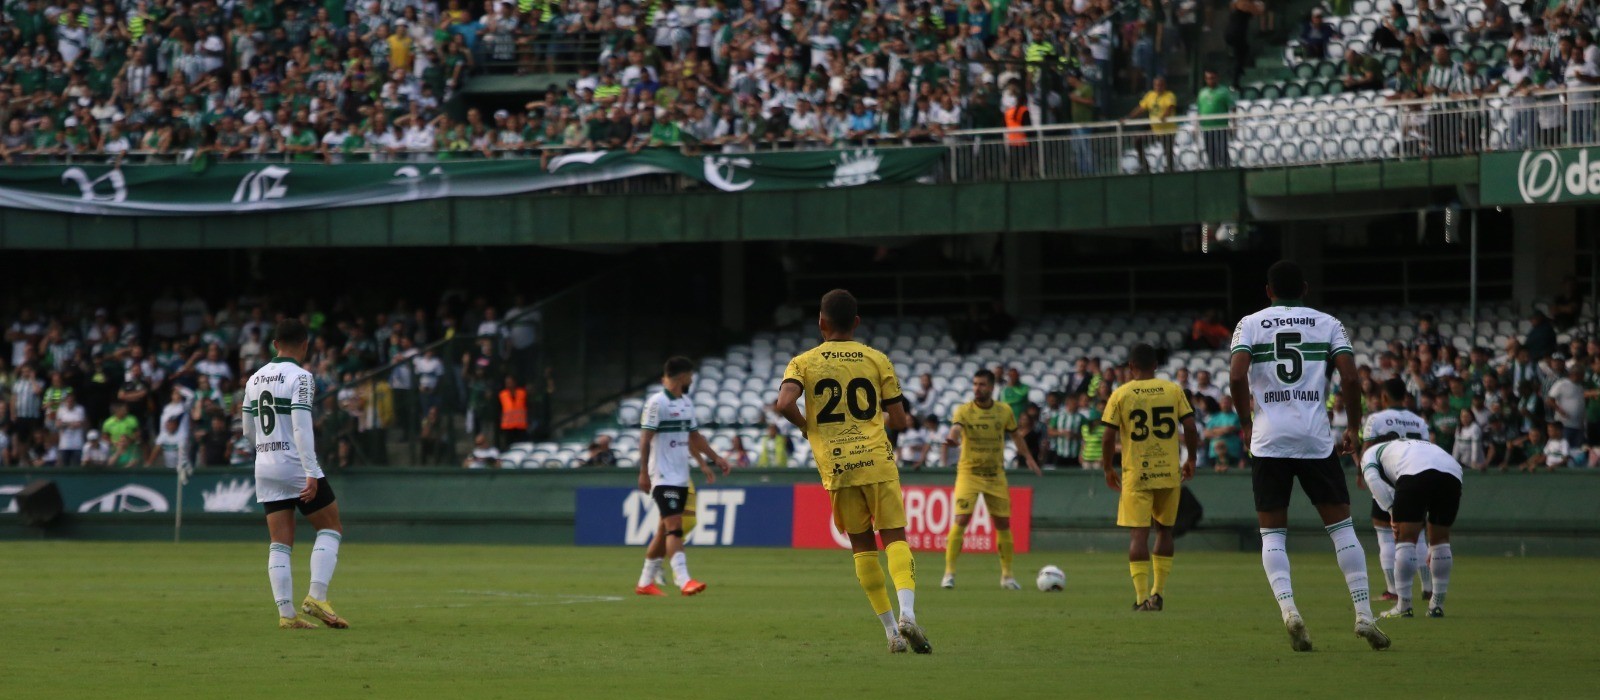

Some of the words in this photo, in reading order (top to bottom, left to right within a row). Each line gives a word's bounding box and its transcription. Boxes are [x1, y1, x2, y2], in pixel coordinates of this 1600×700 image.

[1273, 316, 1316, 327] Tequaly
[1275, 332, 1303, 384] 5
[260, 373, 285, 384] Tequaly
[814, 377, 877, 425] 20
[1264, 389, 1291, 404] BRUNO
[1292, 389, 1320, 402] VIANA
[259, 390, 276, 437] 6
[1129, 406, 1176, 442] 35
[1394, 418, 1420, 429] Tequaly
[844, 460, 874, 470] dipelnet
[622, 489, 746, 546] 1XET
